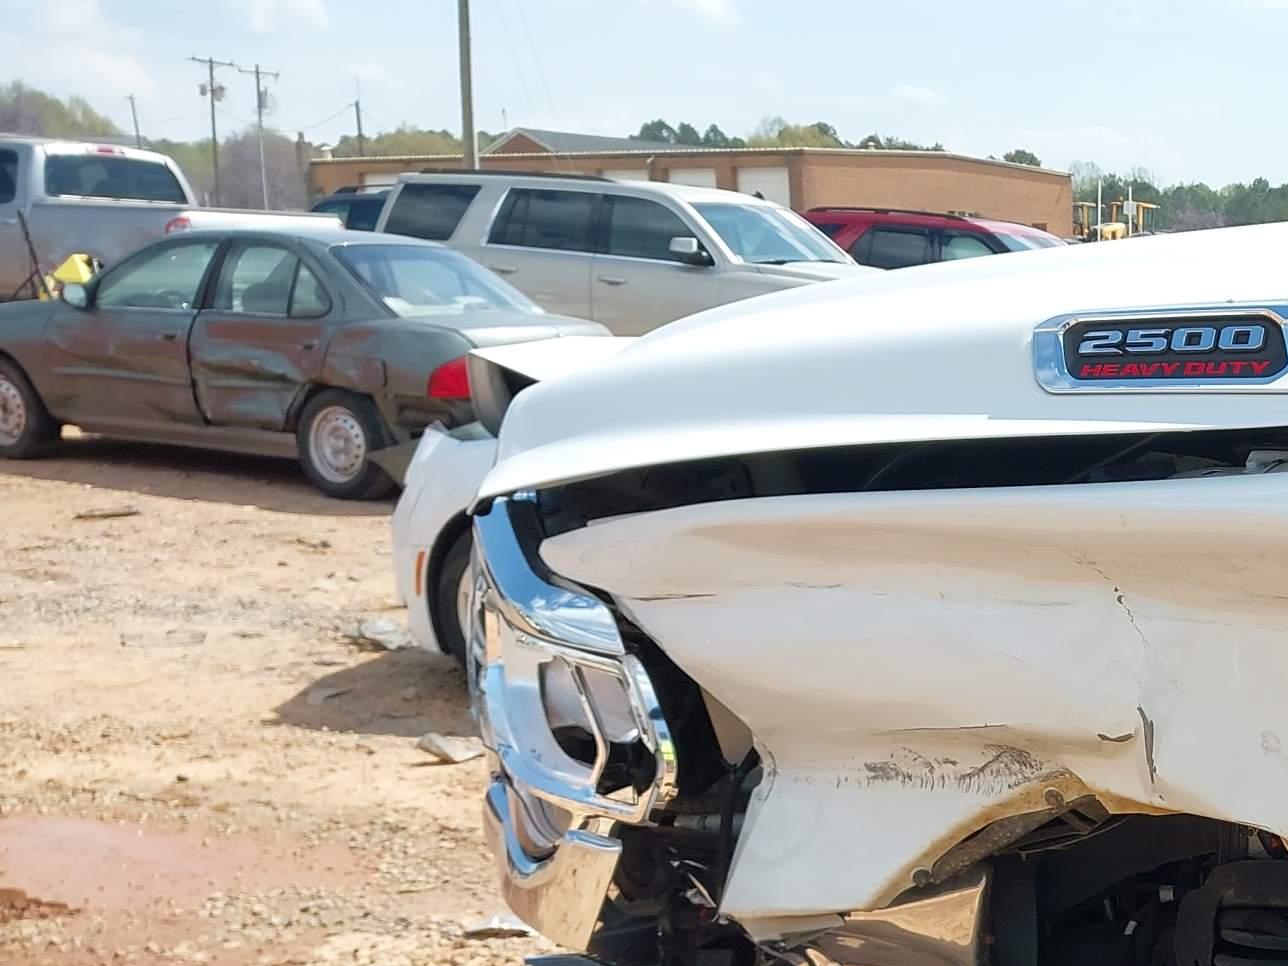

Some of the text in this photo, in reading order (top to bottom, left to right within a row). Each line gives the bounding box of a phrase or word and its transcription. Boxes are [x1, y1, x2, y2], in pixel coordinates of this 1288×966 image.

[1078, 325, 1266, 355] 2500
[1080, 360, 1271, 377] HEAVY DUTY
